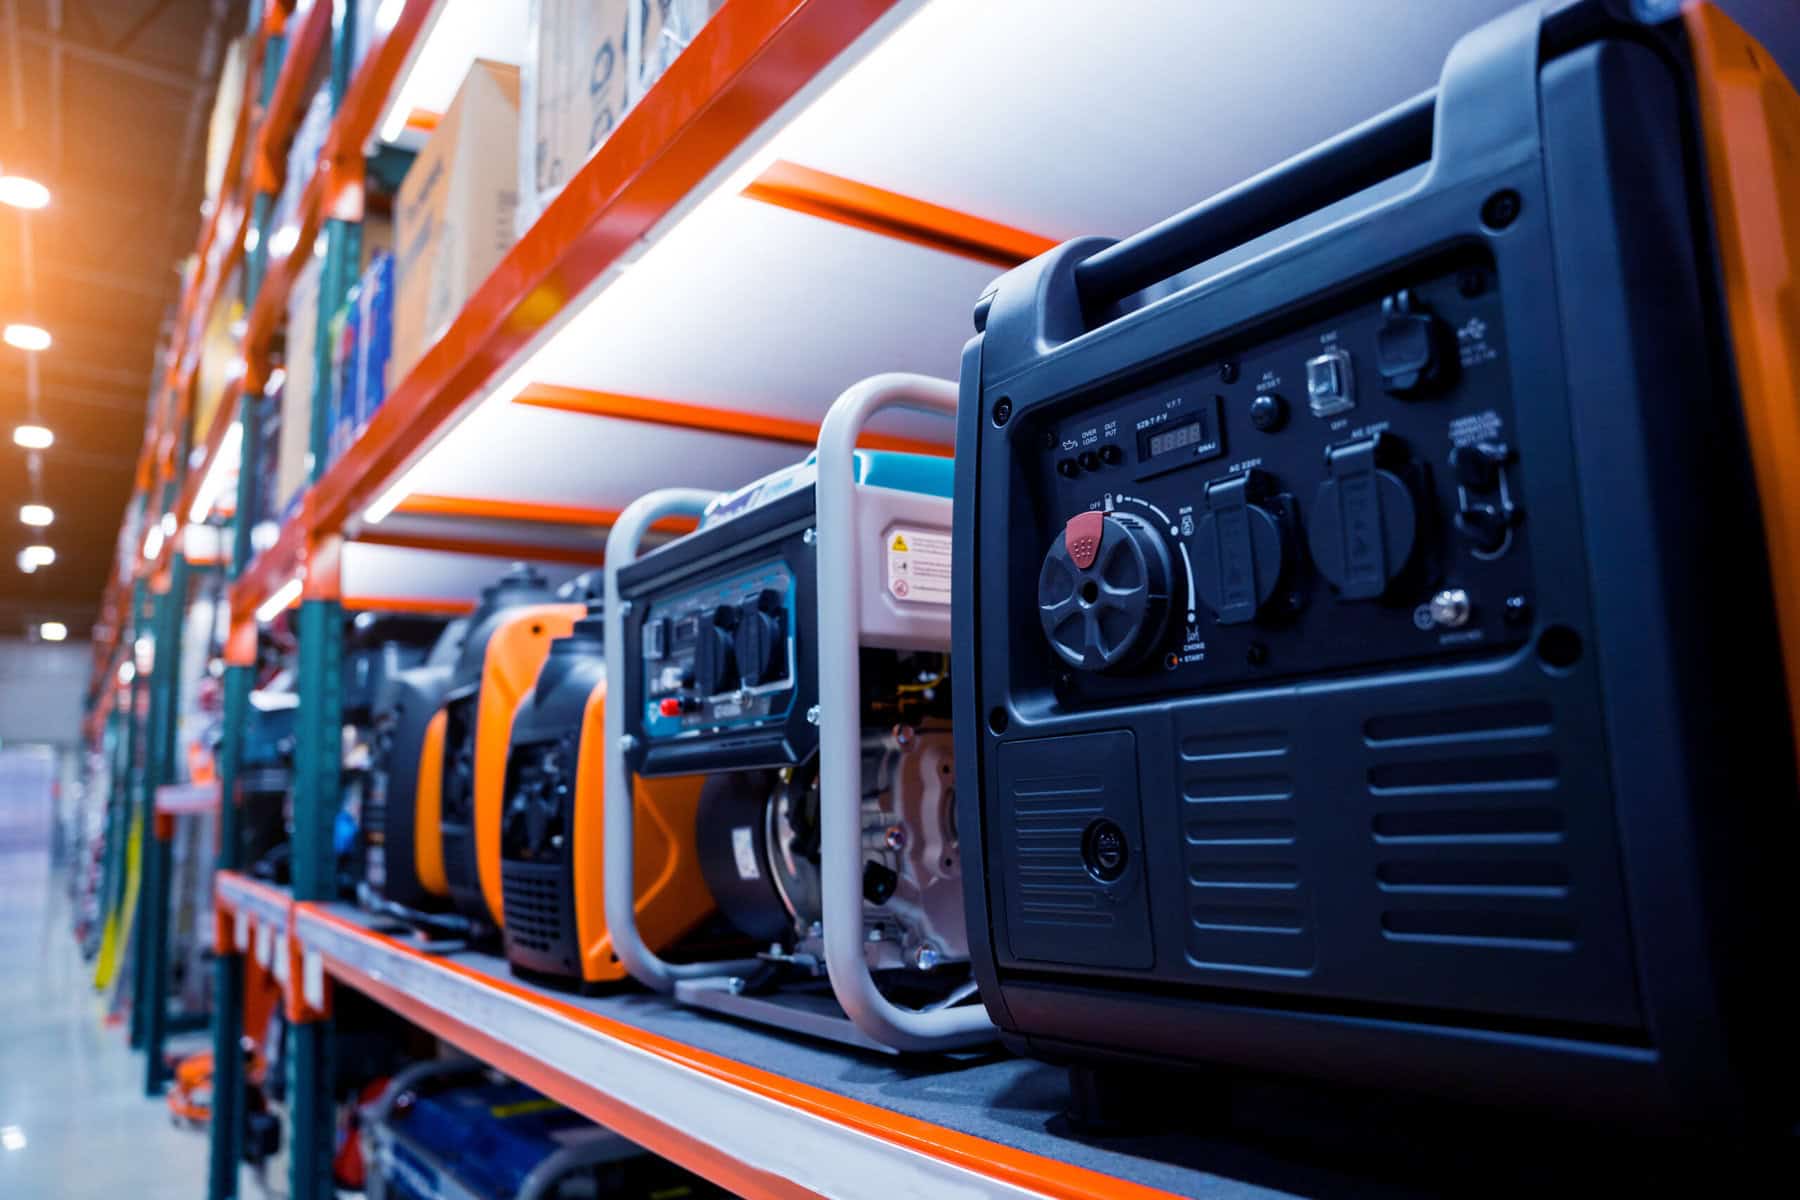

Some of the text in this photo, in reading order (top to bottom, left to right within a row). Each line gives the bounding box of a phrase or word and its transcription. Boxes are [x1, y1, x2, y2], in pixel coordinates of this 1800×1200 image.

[1256, 377, 1281, 391] RESET
[1104, 421, 1116, 431] OUT
[1081, 428, 1097, 439] OVER
[1104, 428, 1117, 438] PUT
[1082, 435, 1098, 446] LOAD
[1229, 463, 1240, 473] AC
[1090, 501, 1101, 510] OFF
[1184, 642, 1205, 652] CHOKE
[1184, 653, 1204, 663] START
